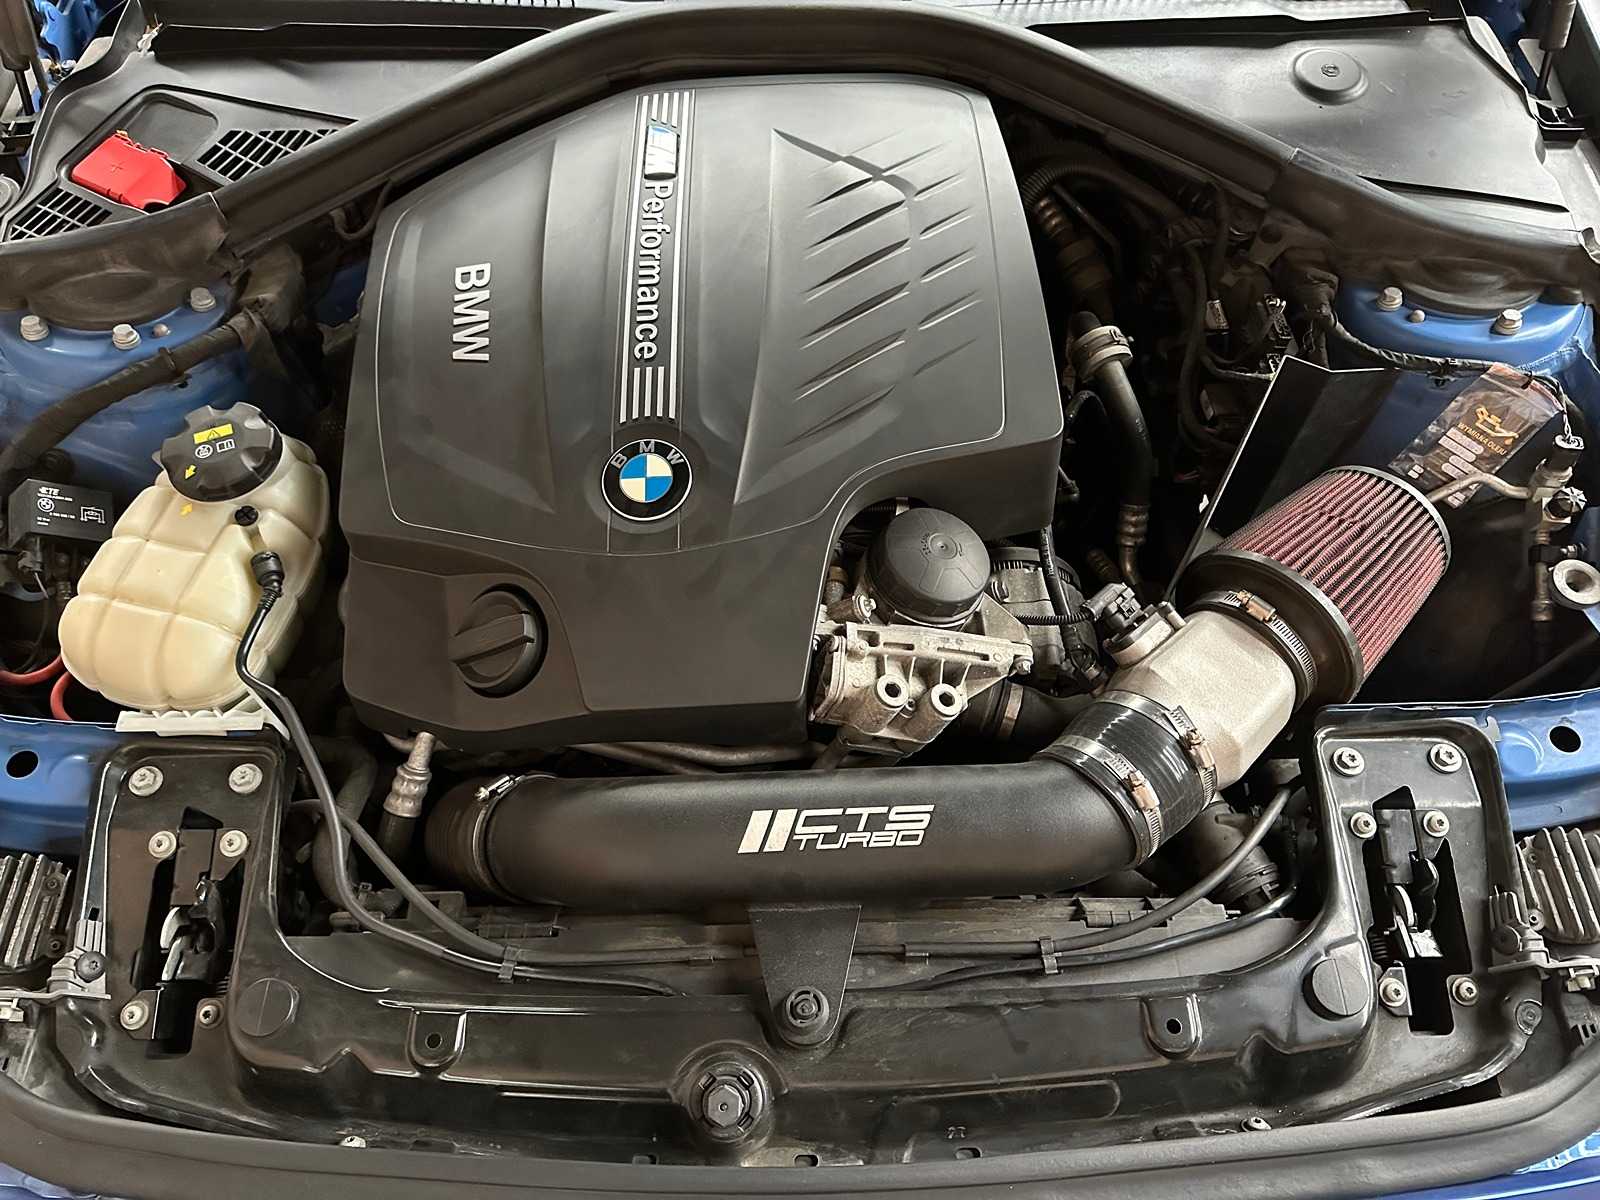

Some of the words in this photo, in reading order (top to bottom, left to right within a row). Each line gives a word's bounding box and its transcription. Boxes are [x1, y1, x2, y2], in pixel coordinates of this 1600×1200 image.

[634, 182, 674, 360] Performance
[452, 262, 491, 361] BMW
[610, 440, 684, 469] BMW
[794, 804, 935, 835] CTS
[792, 829, 925, 851] TURBO
